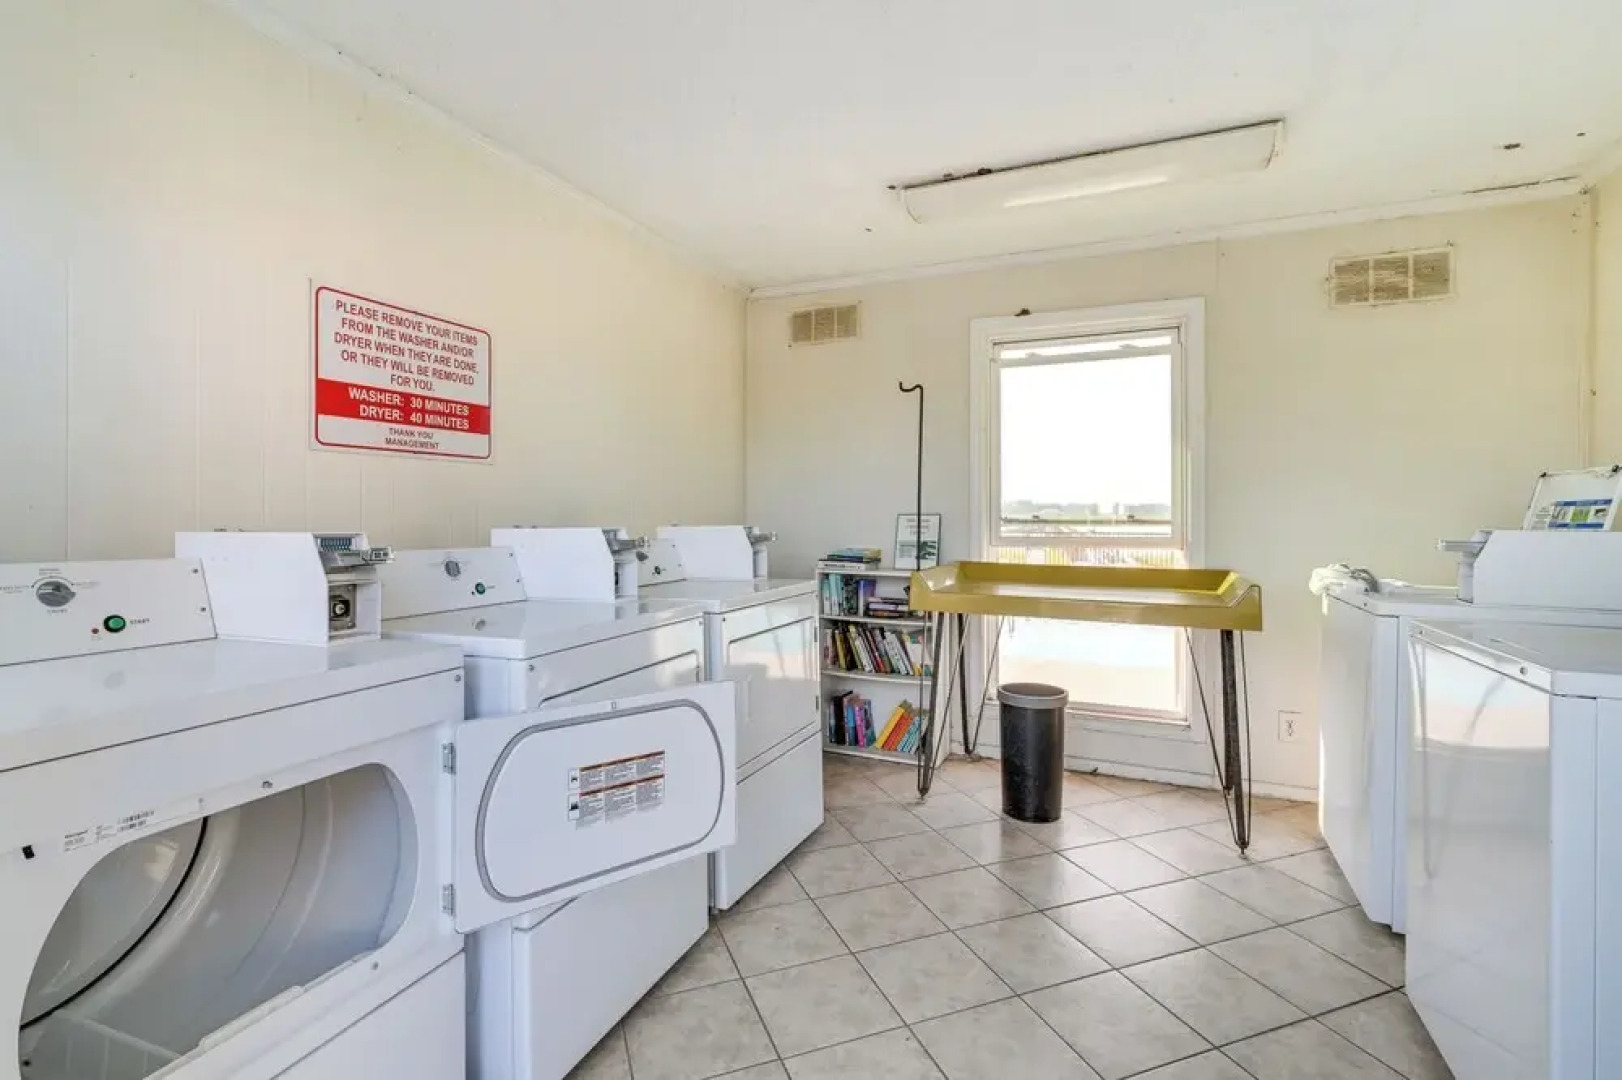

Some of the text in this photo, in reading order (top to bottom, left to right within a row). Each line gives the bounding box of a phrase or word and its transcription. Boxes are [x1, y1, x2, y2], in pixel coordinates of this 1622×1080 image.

[336, 300, 478, 345] PLEASE REMOVE YOUR ITEMS
[334, 332, 371, 350] DRYER
[375, 340, 405, 357] WHEN
[407, 348, 432, 363] THEY
[433, 355, 451, 368] ARE
[342, 318, 474, 358] FROM THE WASHER AND/OR
[341, 350, 474, 385] OR THEY WILL BE REMOVED
[391, 374, 435, 391] FOR YOU.
[348, 387, 469, 416] WASHER: 30 MINUTES
[360, 405, 469, 429] DRYER: 40 MINUTES
[385, 438, 439, 449] MANAGEMENT
[388, 428, 434, 440] THANK YOU
